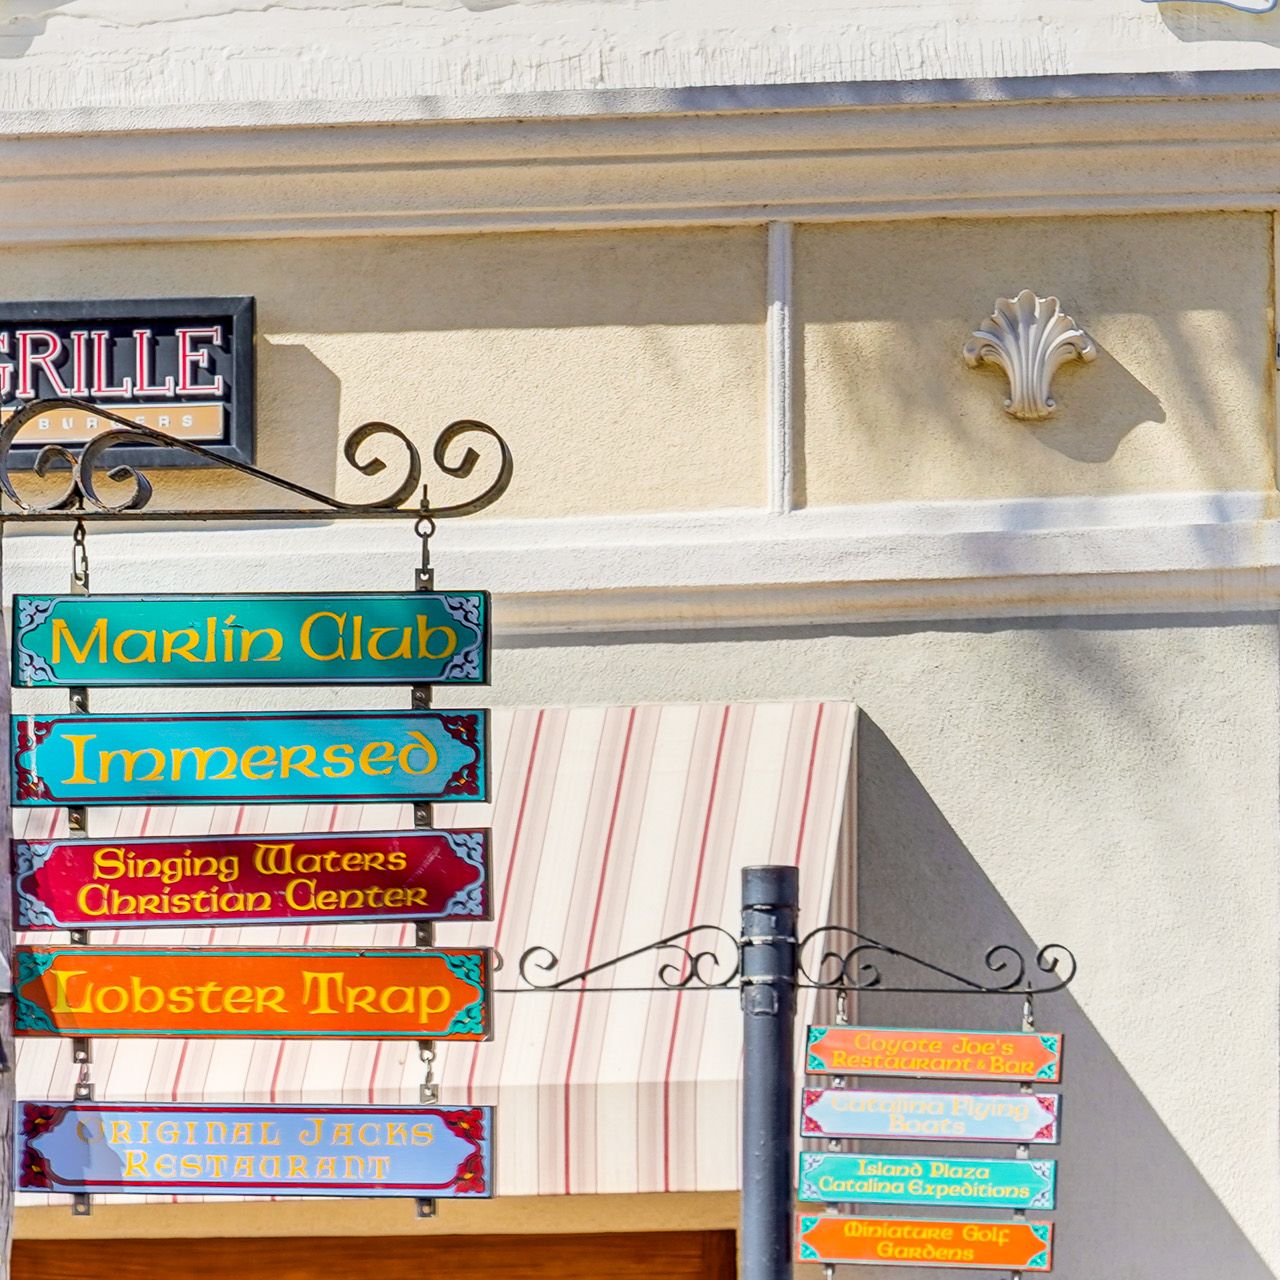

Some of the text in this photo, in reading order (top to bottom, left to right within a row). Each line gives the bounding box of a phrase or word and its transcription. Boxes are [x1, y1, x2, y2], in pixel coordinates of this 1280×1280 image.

[51, 611, 458, 664] Marlin Club
[60, 731, 439, 786] Immersed
[93, 842, 407, 884] Singing Waters
[78, 878, 428, 916] Christian Center
[50, 969, 452, 1024] Lobster Trap
[854, 1032, 1014, 1056] Coyote Joe's
[832, 1050, 971, 1072] Restaurant
[989, 1056, 1035, 1074] Bar
[888, 1113, 967, 1135] Boats
[858, 1158, 990, 1179] Island Plaza
[818, 1176, 1030, 1199] Catalina Expeditions
[844, 1220, 1010, 1247] Miniature Golf
[876, 1242, 975, 1262] Gardens
